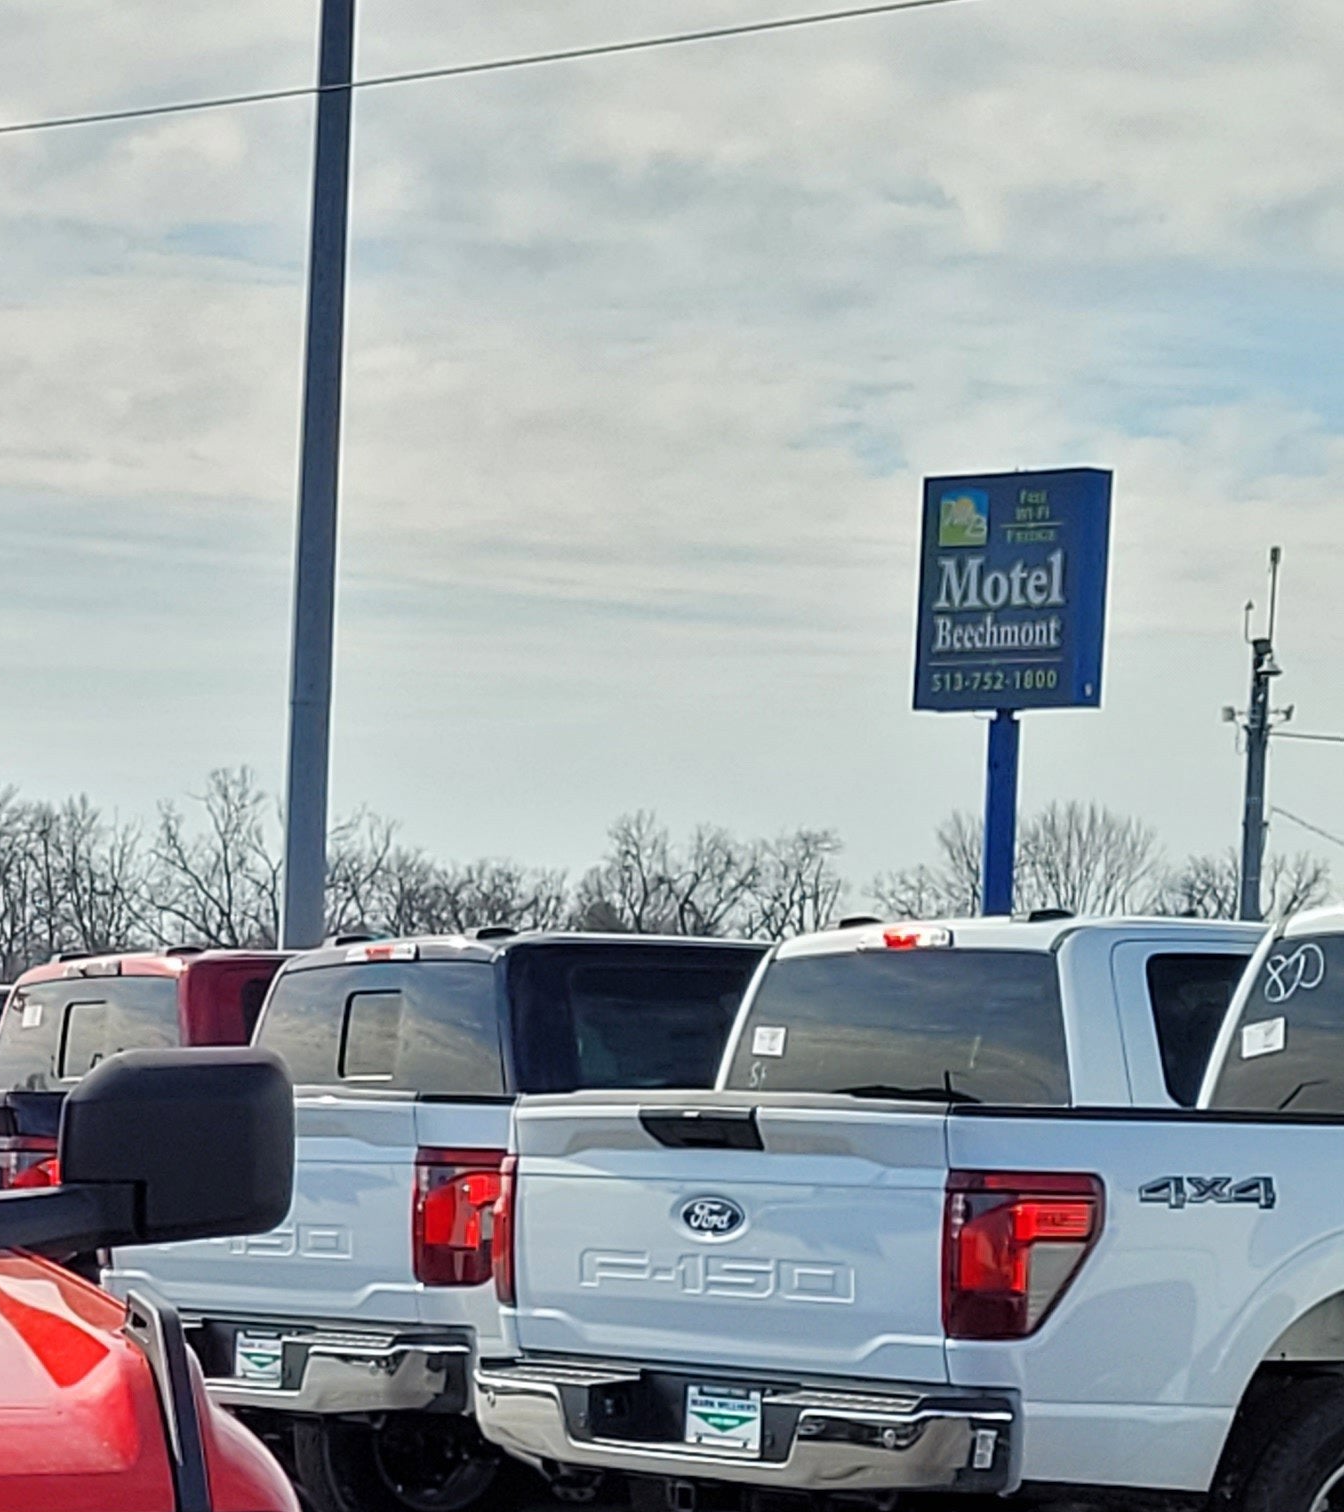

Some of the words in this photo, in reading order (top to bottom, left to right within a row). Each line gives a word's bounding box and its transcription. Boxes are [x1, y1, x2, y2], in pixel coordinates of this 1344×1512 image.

[933, 550, 1065, 607] Motel
[933, 614, 1060, 650] Beechmont
[689, 1204, 730, 1229] Ford
[579, 1248, 855, 1304] F-150
